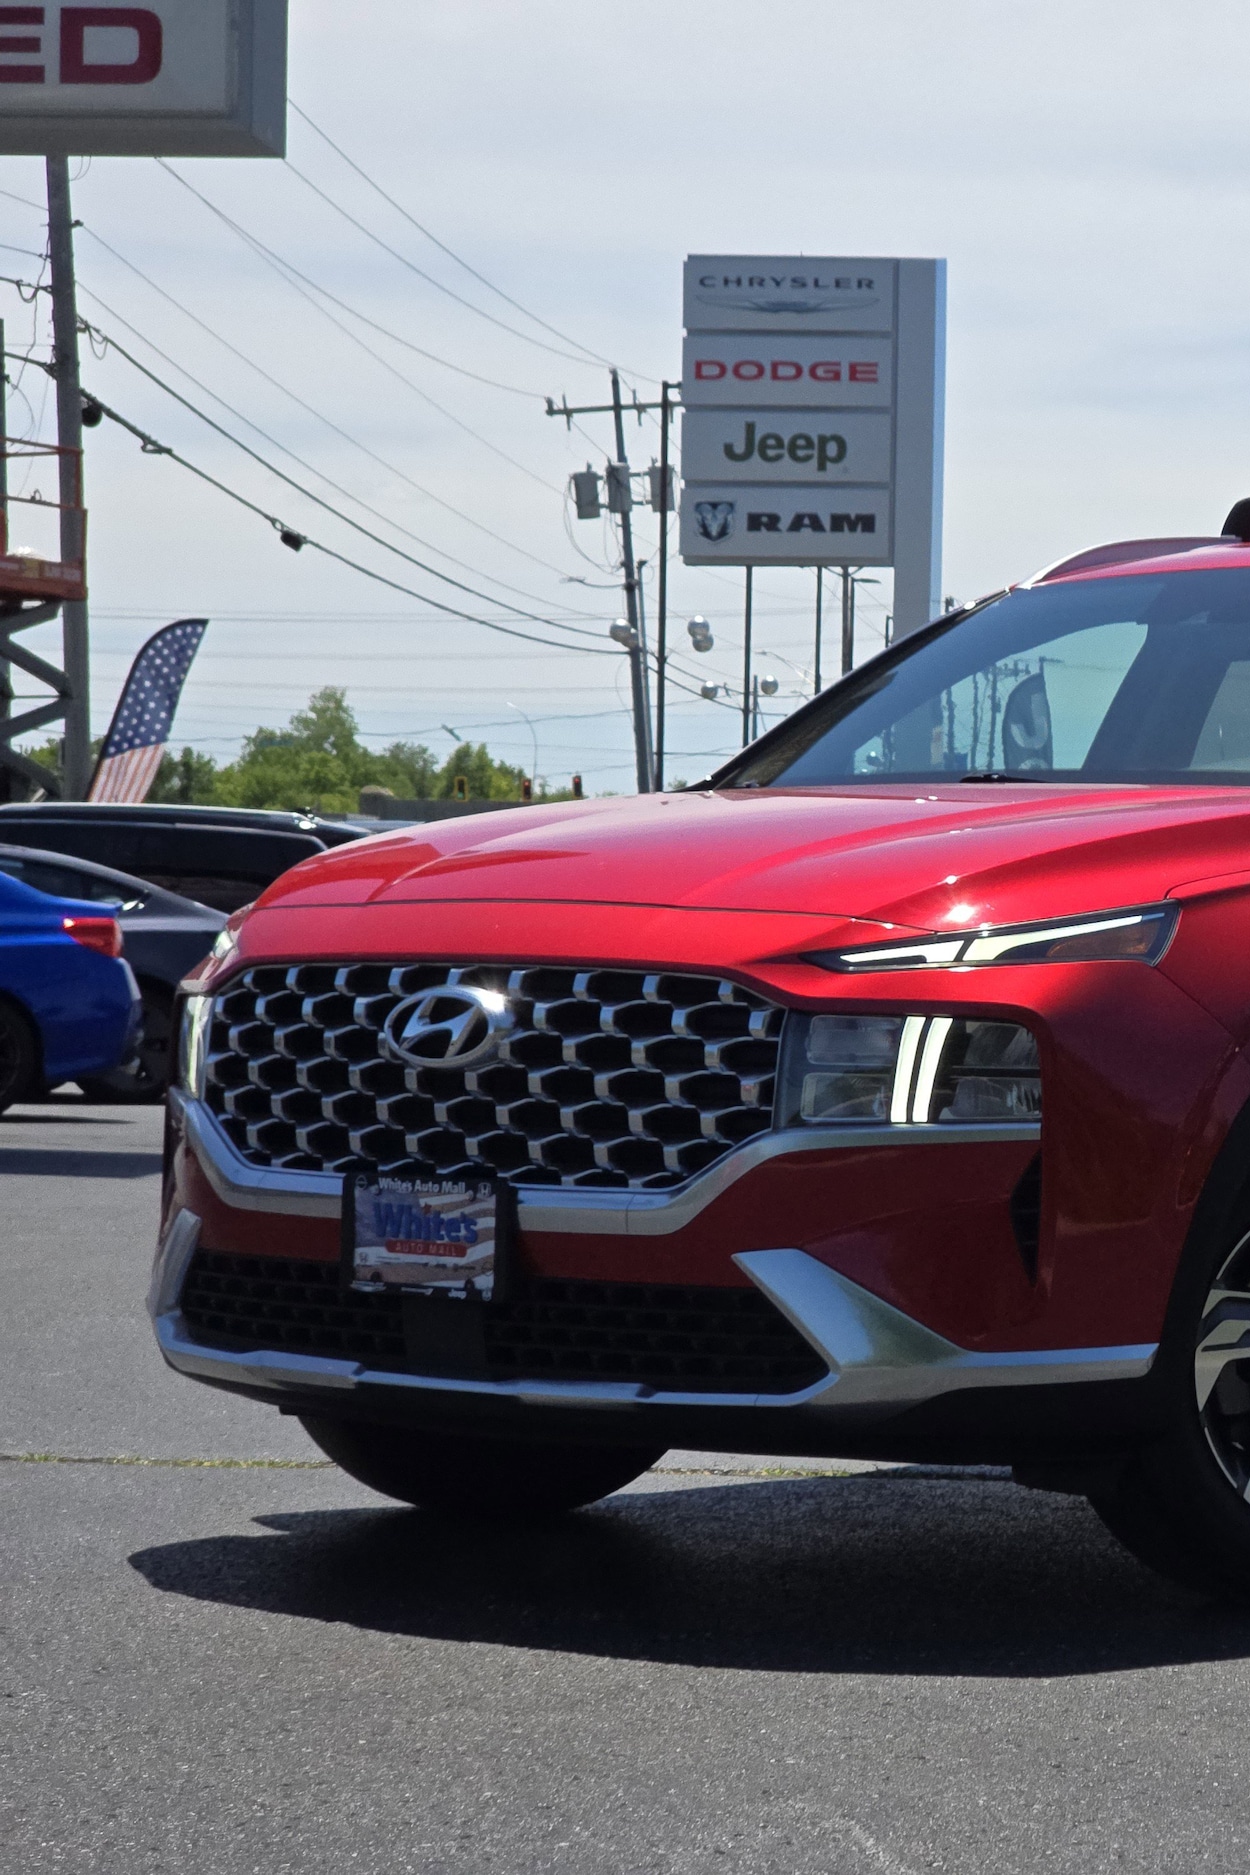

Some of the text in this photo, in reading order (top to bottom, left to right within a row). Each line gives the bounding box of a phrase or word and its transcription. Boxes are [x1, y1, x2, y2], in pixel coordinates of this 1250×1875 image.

[698, 275, 875, 290] CHRYSLER
[694, 359, 879, 383] DODGE
[722, 421, 848, 472] Jeep
[746, 512, 876, 533] RAM
[414, 1180, 439, 1193] Auto
[441, 1181, 466, 1194] Mall
[373, 1202, 478, 1243] White's
[395, 1241, 457, 1256] AUTO MALL
